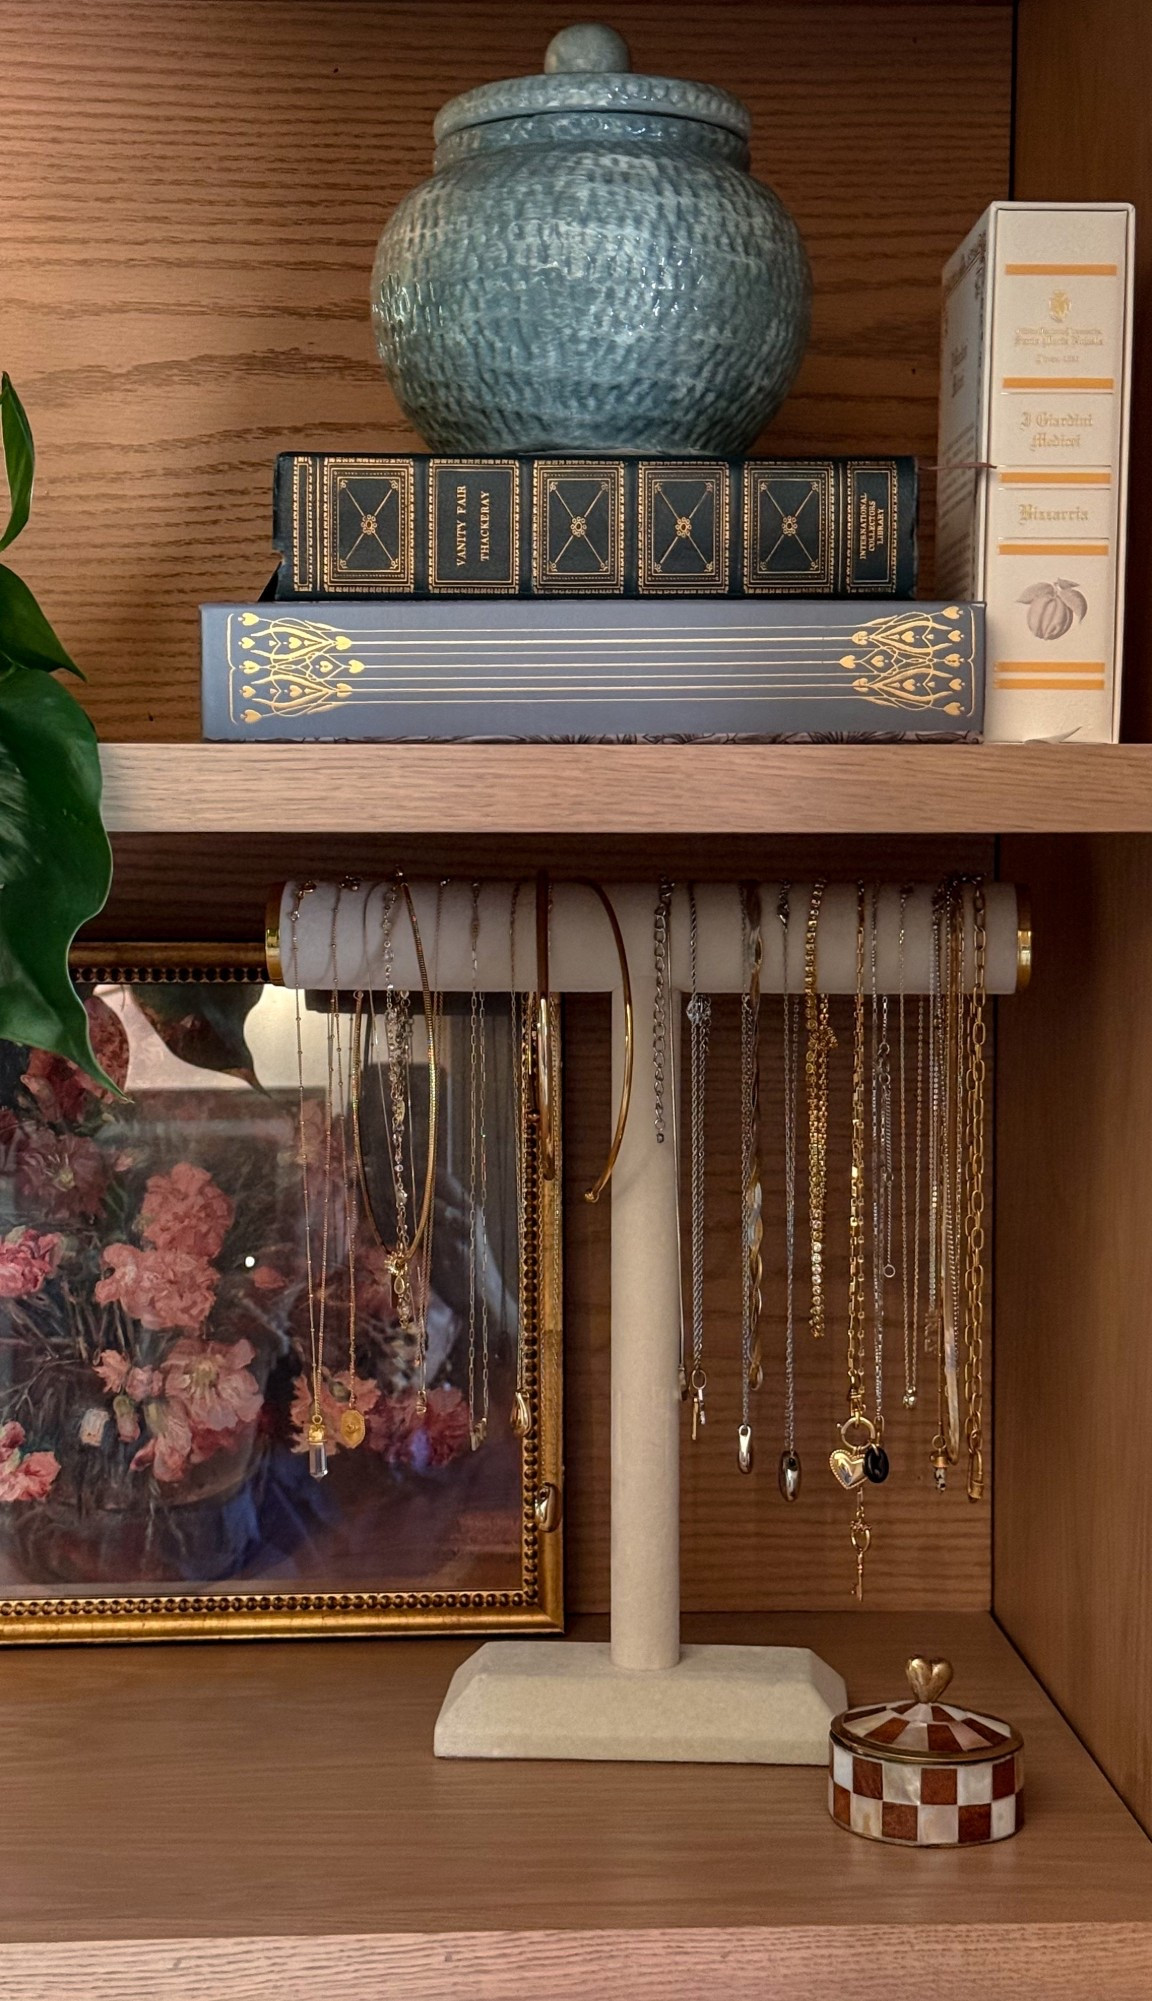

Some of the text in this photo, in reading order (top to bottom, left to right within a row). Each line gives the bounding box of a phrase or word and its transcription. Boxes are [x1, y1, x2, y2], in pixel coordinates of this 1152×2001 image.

[456, 485, 467, 567] VANITY FAIR
[480, 490, 490, 562] THACKERAY
[859, 492, 867, 560] INTERNATIONAL
[868, 500, 876, 552] COLLECTORS
